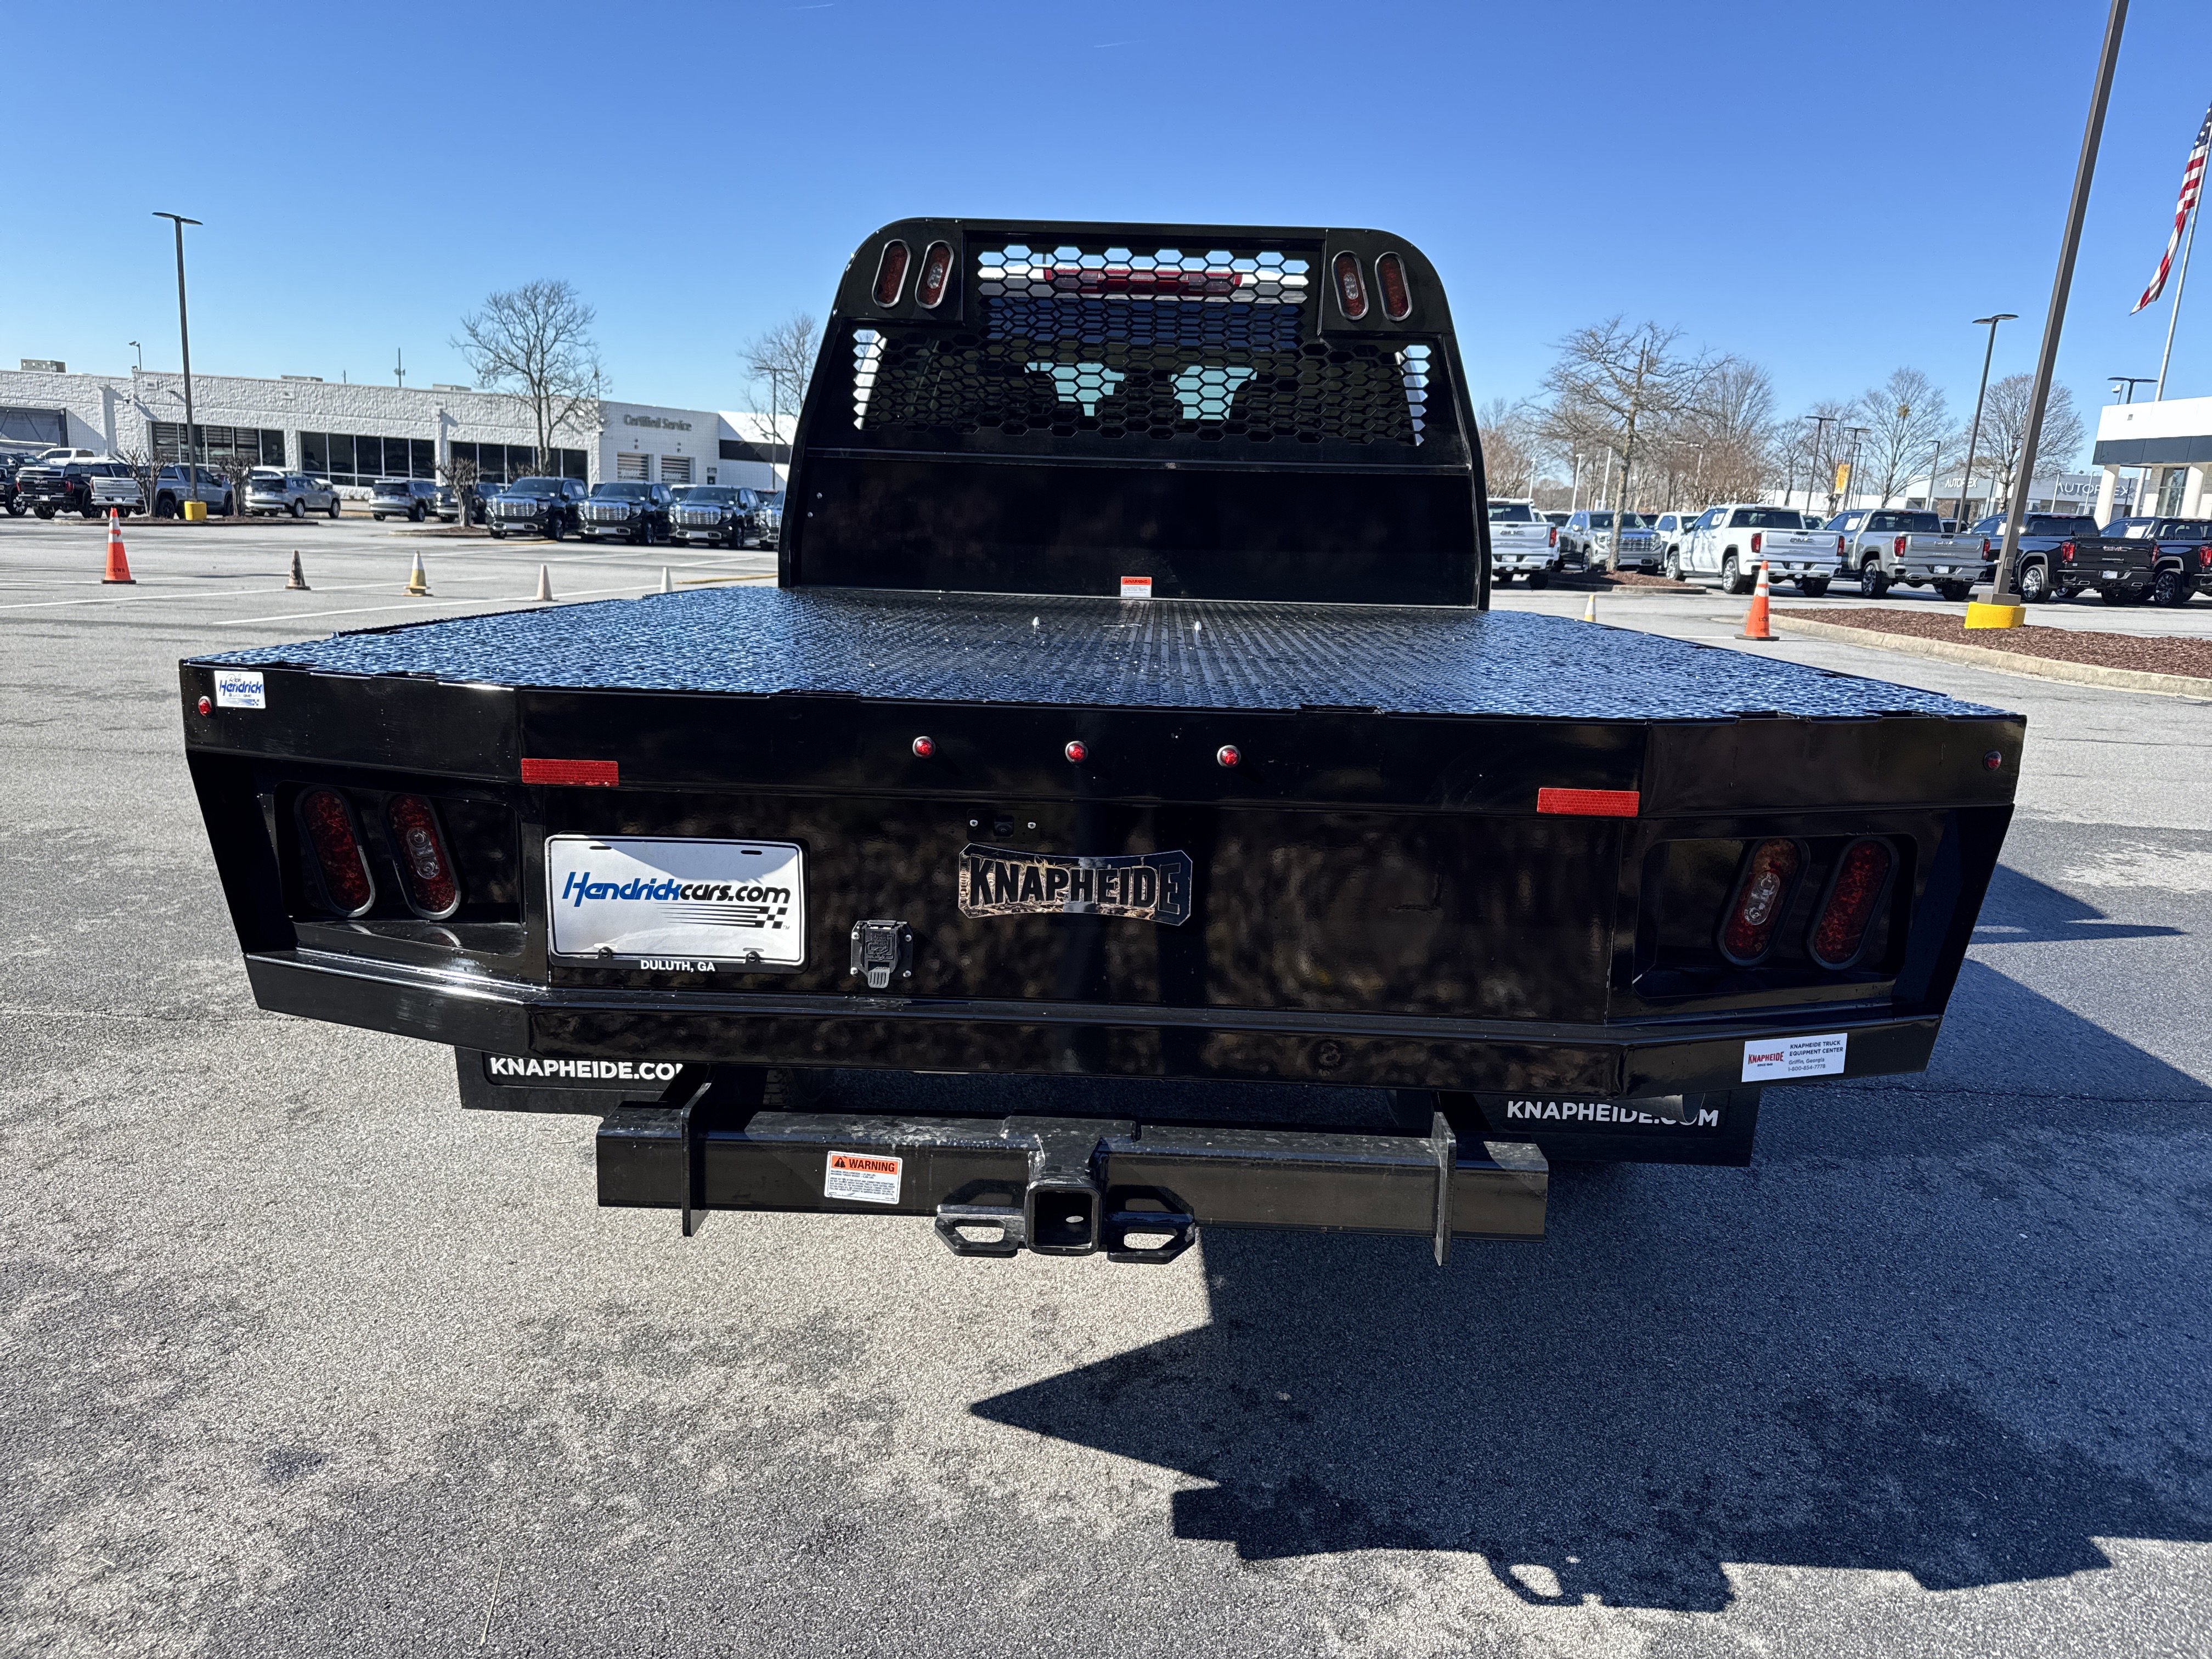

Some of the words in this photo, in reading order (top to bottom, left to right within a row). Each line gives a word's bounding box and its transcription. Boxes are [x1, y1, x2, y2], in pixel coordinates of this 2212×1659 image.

[623, 414, 662, 428] Certified
[662, 418, 692, 431] Service
[1944, 477, 1978, 488] AUTOPEX
[2055, 482, 2130, 496] AUTOPEX
[219, 680, 263, 696] Hendrick
[562, 872, 791, 907] Hendrickcars.com
[969, 855, 1182, 915] KNAPHEIDE
[640, 960, 693, 972] DULUTH,
[697, 961, 715, 972] GA
[1747, 1051, 1785, 1064] KNAPHEIDE
[490, 1057, 684, 1081] KNAPHEIDE.CO
[1507, 1101, 1719, 1127] KNAPHEIDE.M
[849, 1159, 895, 1172] WARNING
